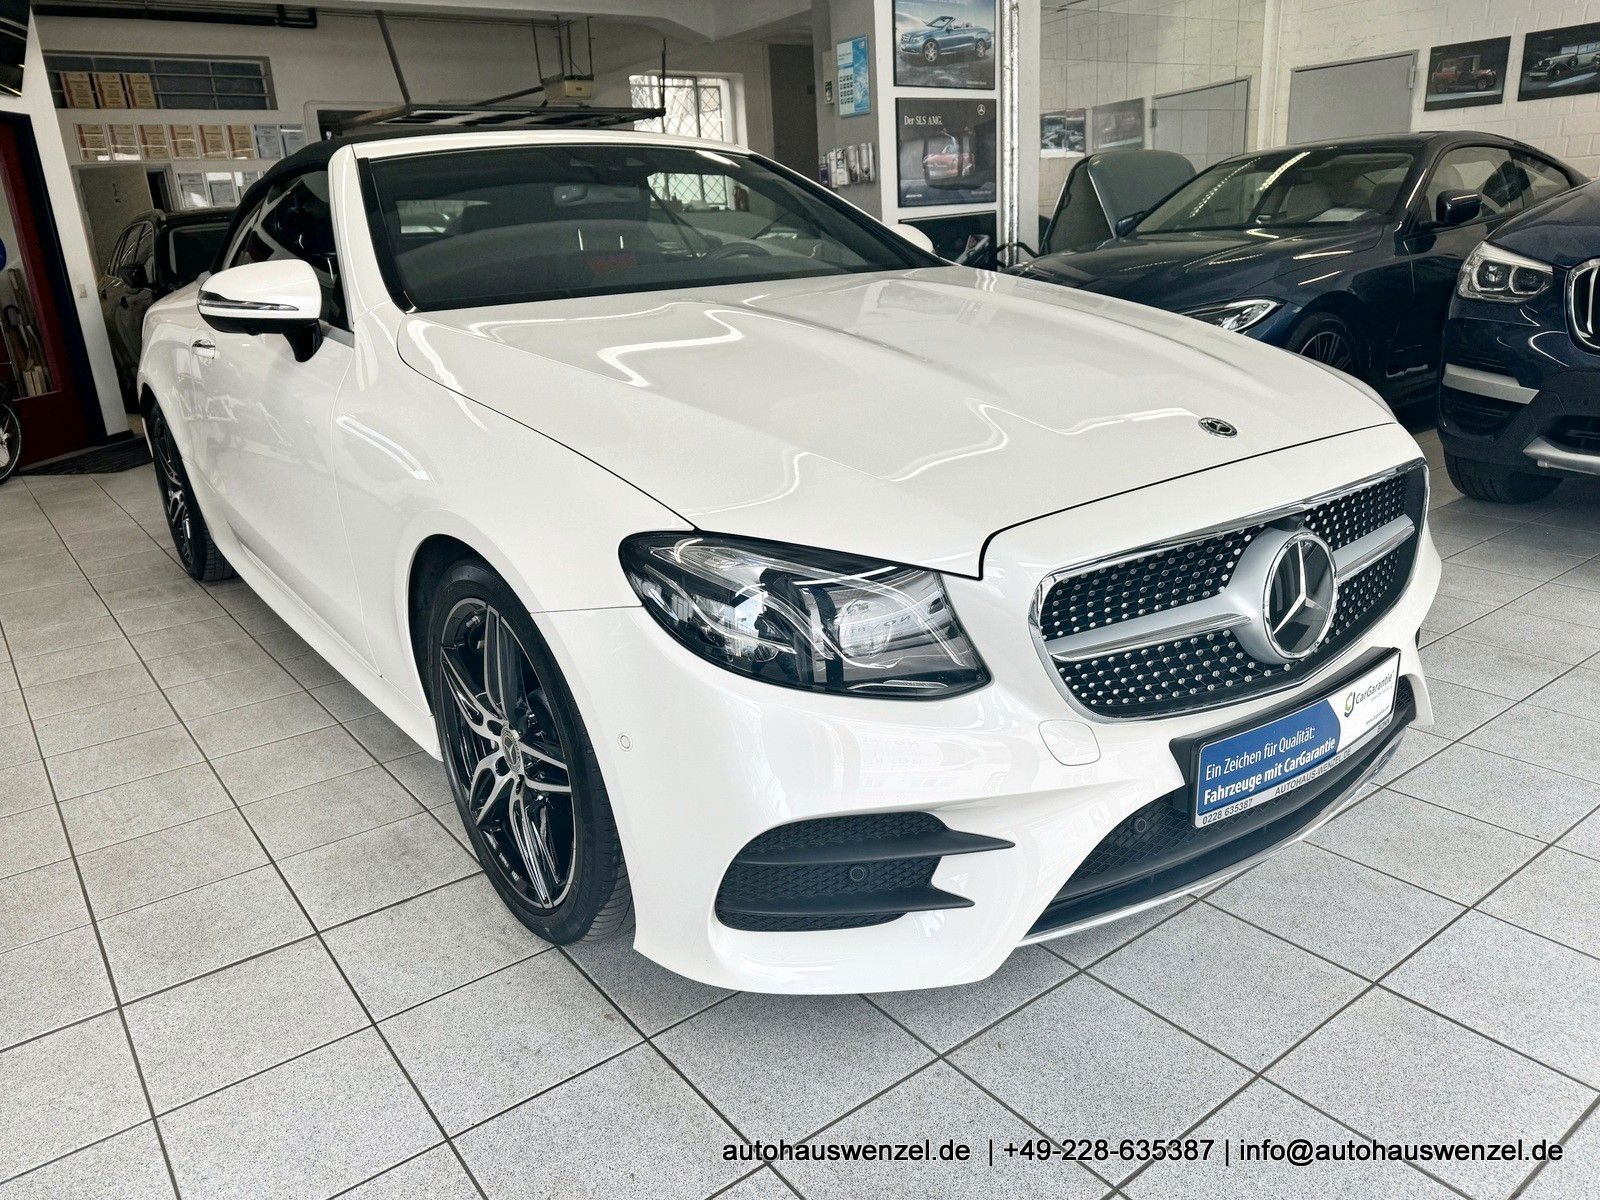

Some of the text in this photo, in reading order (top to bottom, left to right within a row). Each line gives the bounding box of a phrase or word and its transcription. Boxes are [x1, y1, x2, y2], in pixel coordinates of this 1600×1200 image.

[904, 115, 914, 126] Der
[915, 115, 927, 126] SLS
[1203, 737, 1337, 806] Fahrzeuge mit CarGarantie
[1205, 726, 1316, 782] Ein Zeichen für Qualität:
[1202, 810, 1223, 825] 0228
[1224, 798, 1254, 818] 635387
